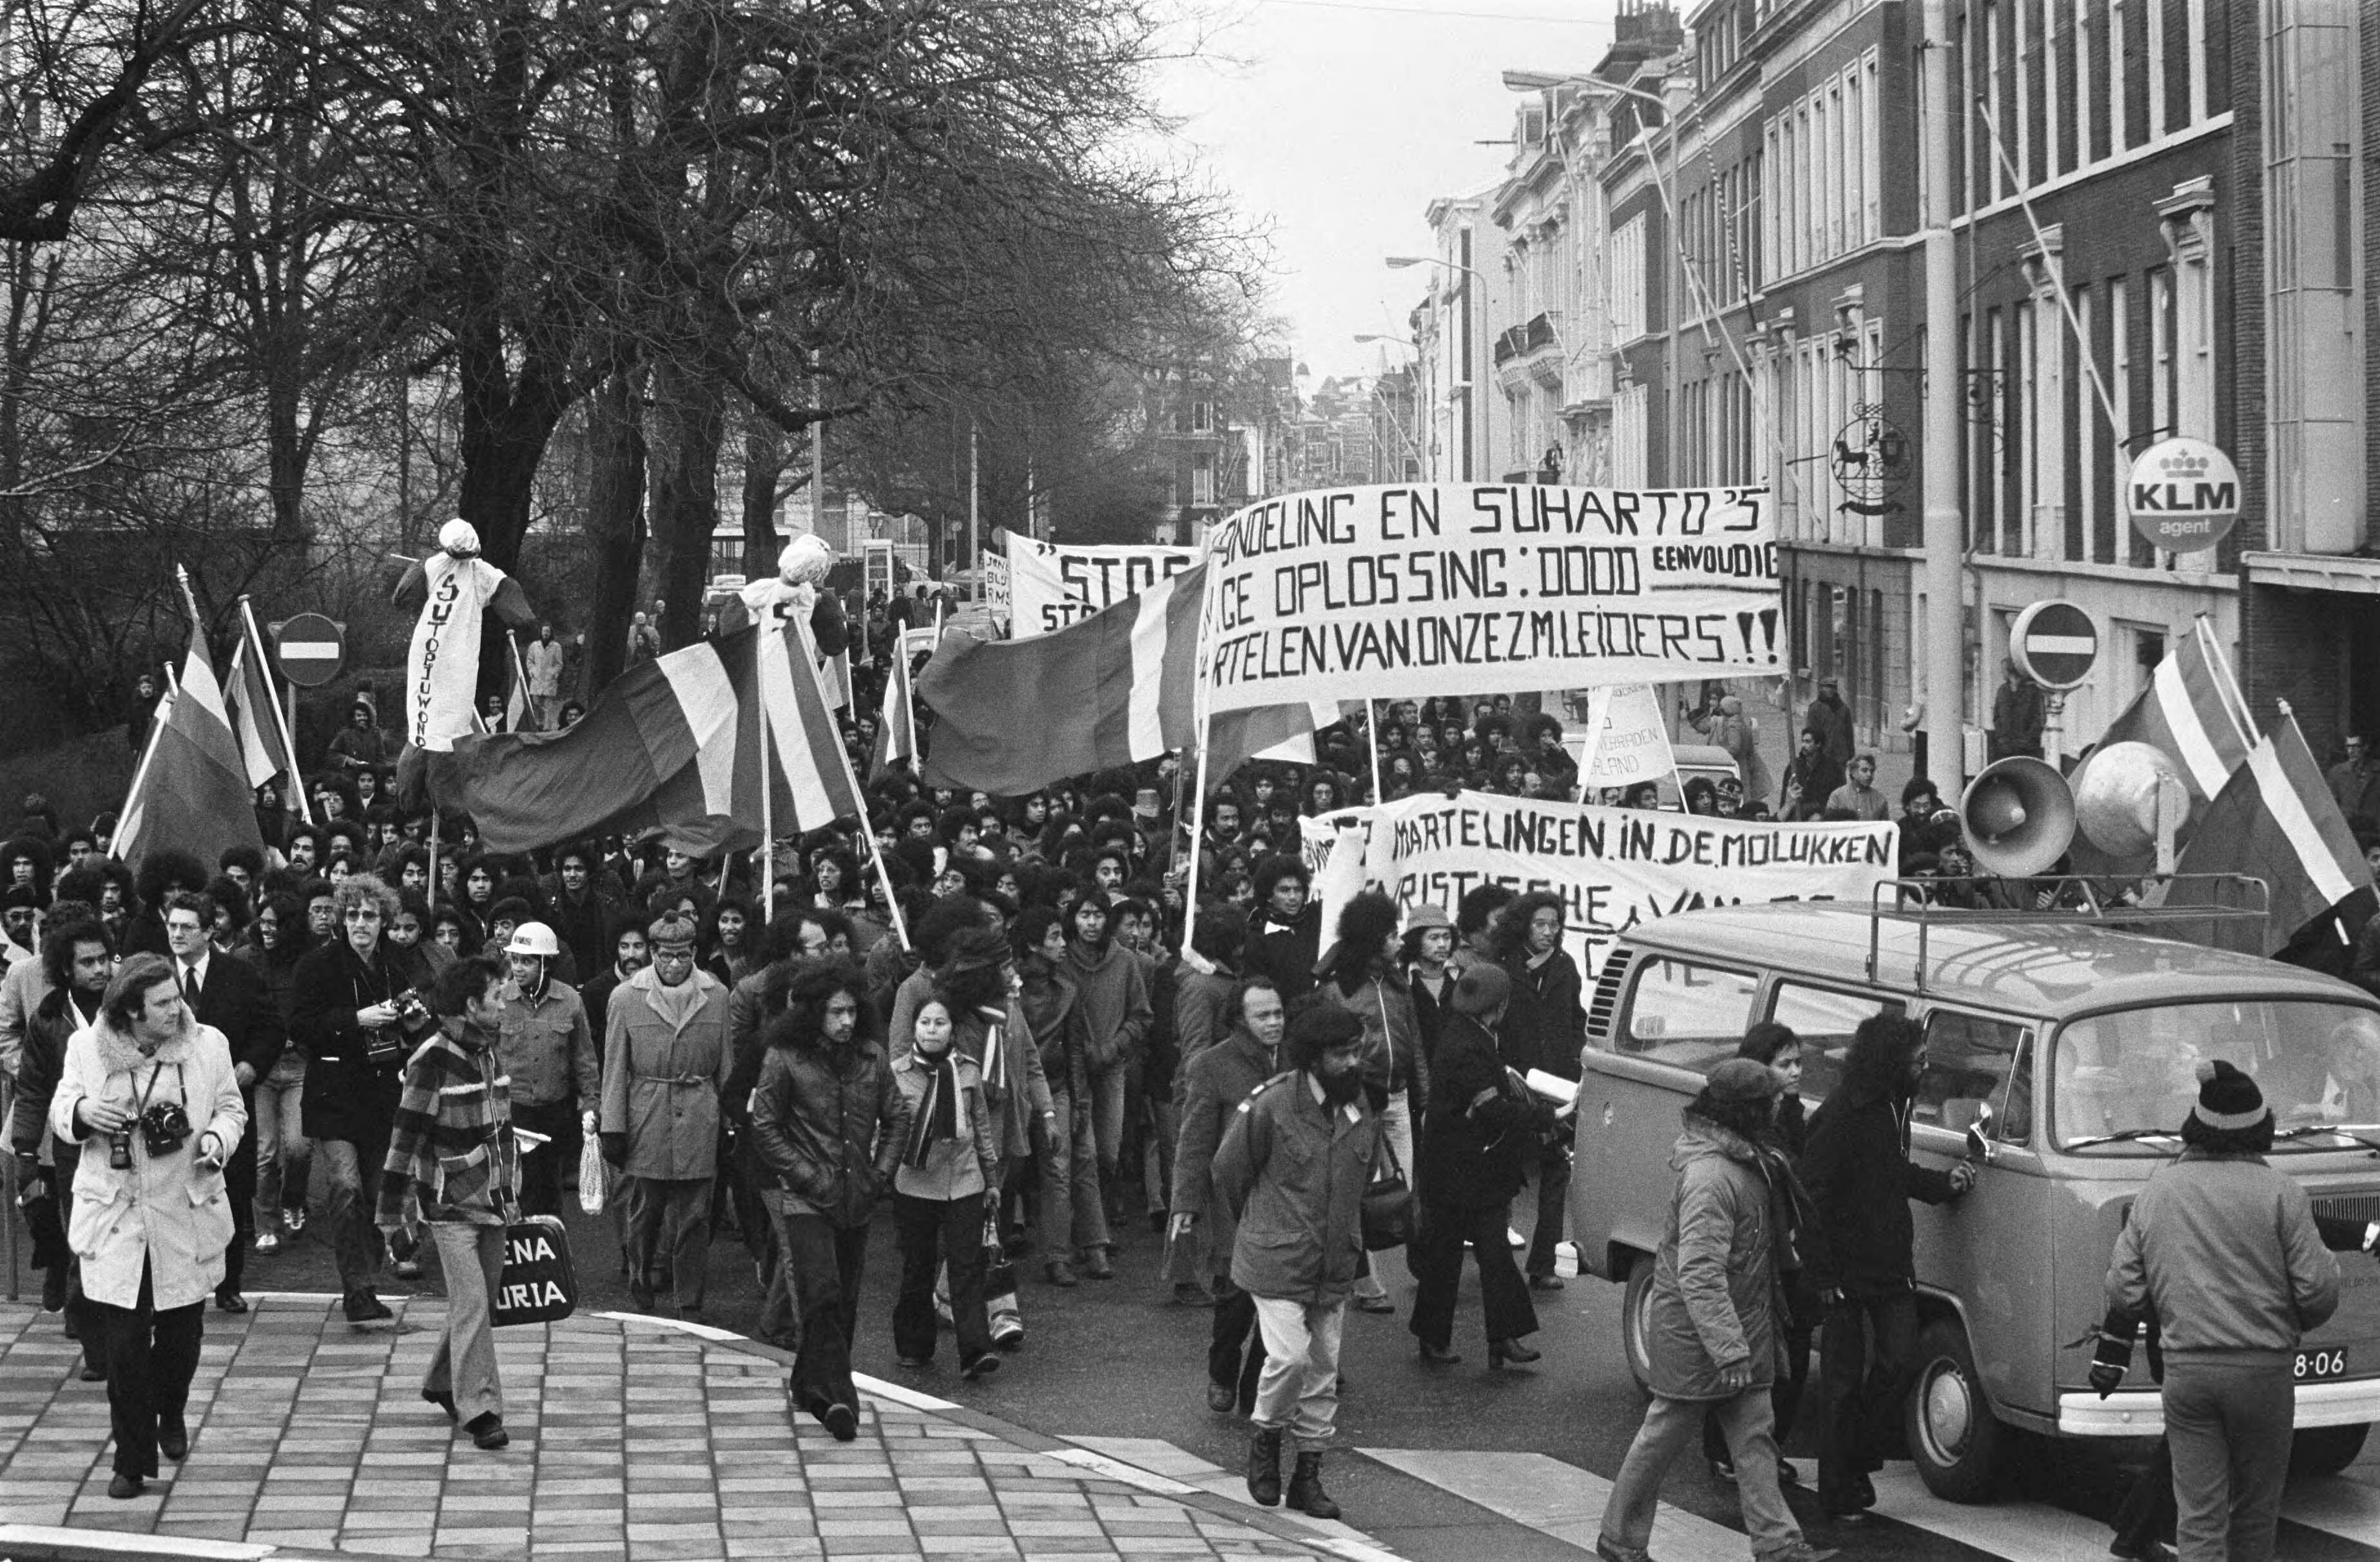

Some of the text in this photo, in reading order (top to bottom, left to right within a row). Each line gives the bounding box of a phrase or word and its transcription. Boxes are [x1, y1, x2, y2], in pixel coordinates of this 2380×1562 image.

[1381, 488, 1440, 540] EN
[1470, 486, 1770, 535] SUHARTO'S
[2134, 483, 2234, 510] KLM
[2160, 518, 2211, 536] agent
[1537, 546, 1640, 596] DOOD
[1721, 830, 1892, 867] MOLUKKEN
